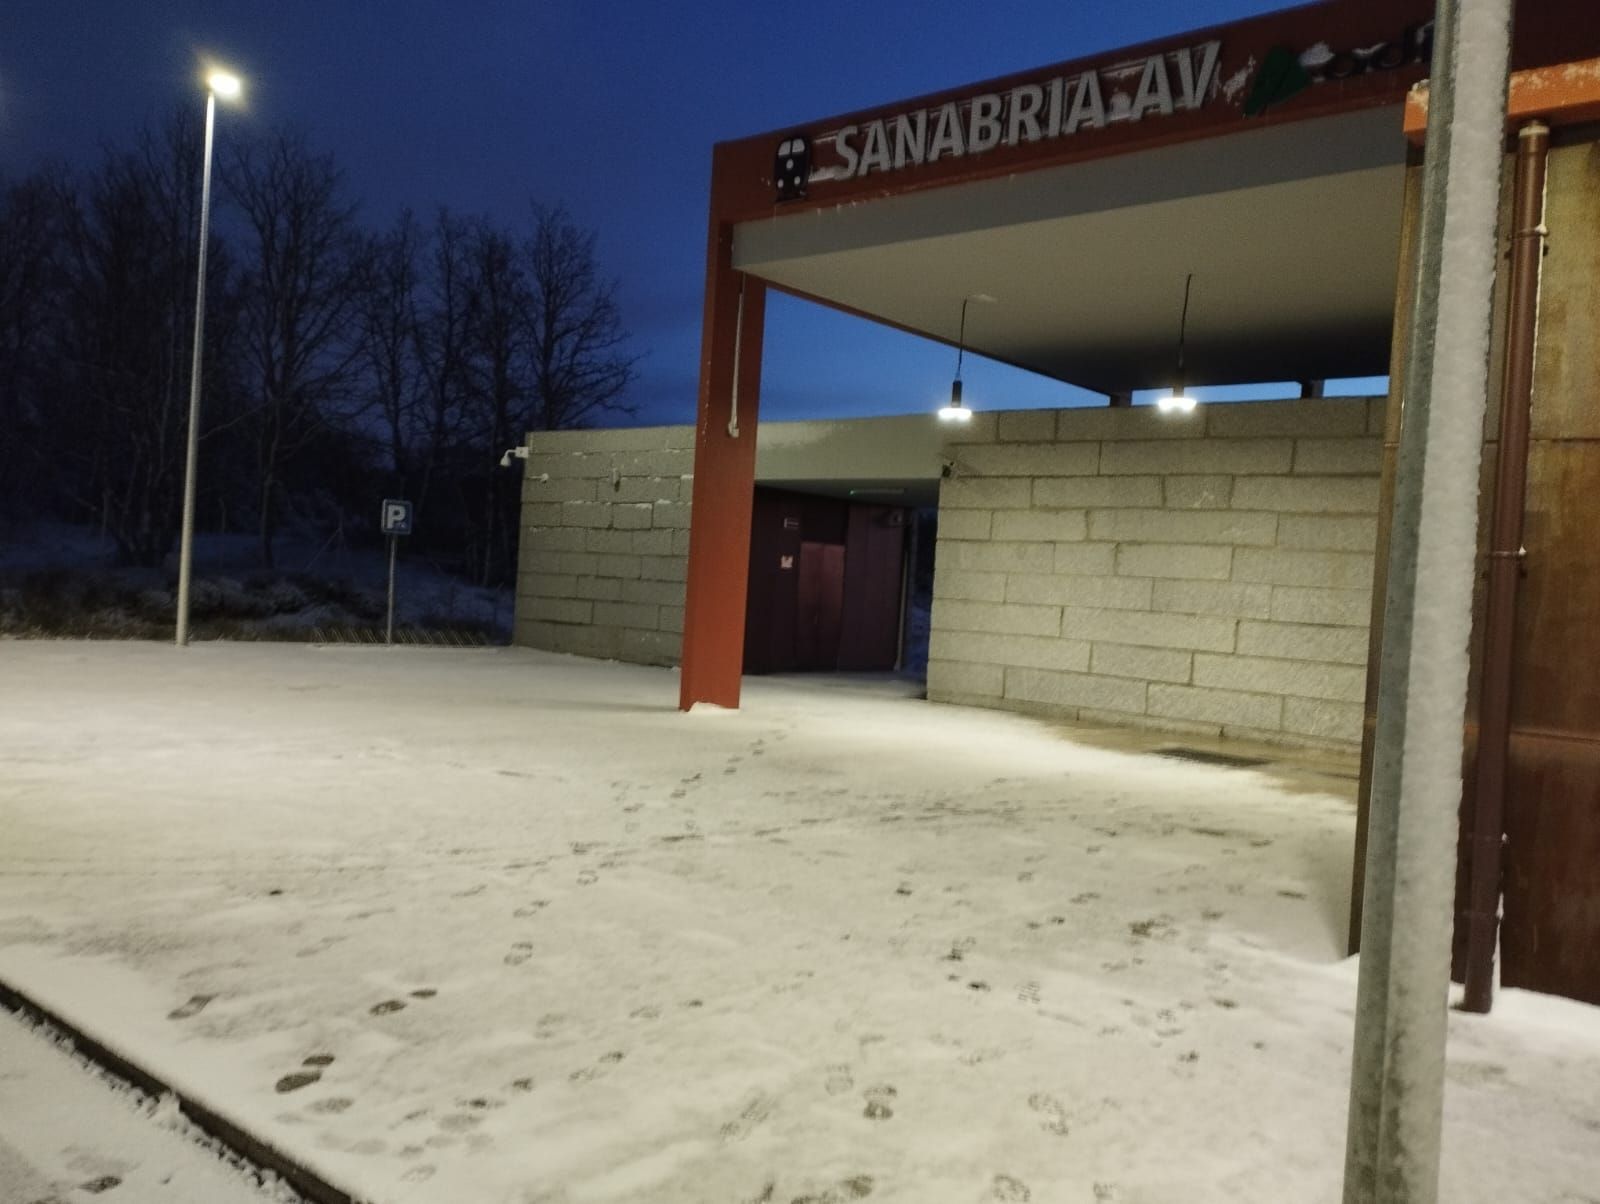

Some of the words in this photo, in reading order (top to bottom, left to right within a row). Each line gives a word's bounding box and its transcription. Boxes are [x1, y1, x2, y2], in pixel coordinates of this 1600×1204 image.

[834, 69, 1106, 180] SANABRIA
[1130, 40, 1222, 121] AV
[387, 504, 406, 529] P
